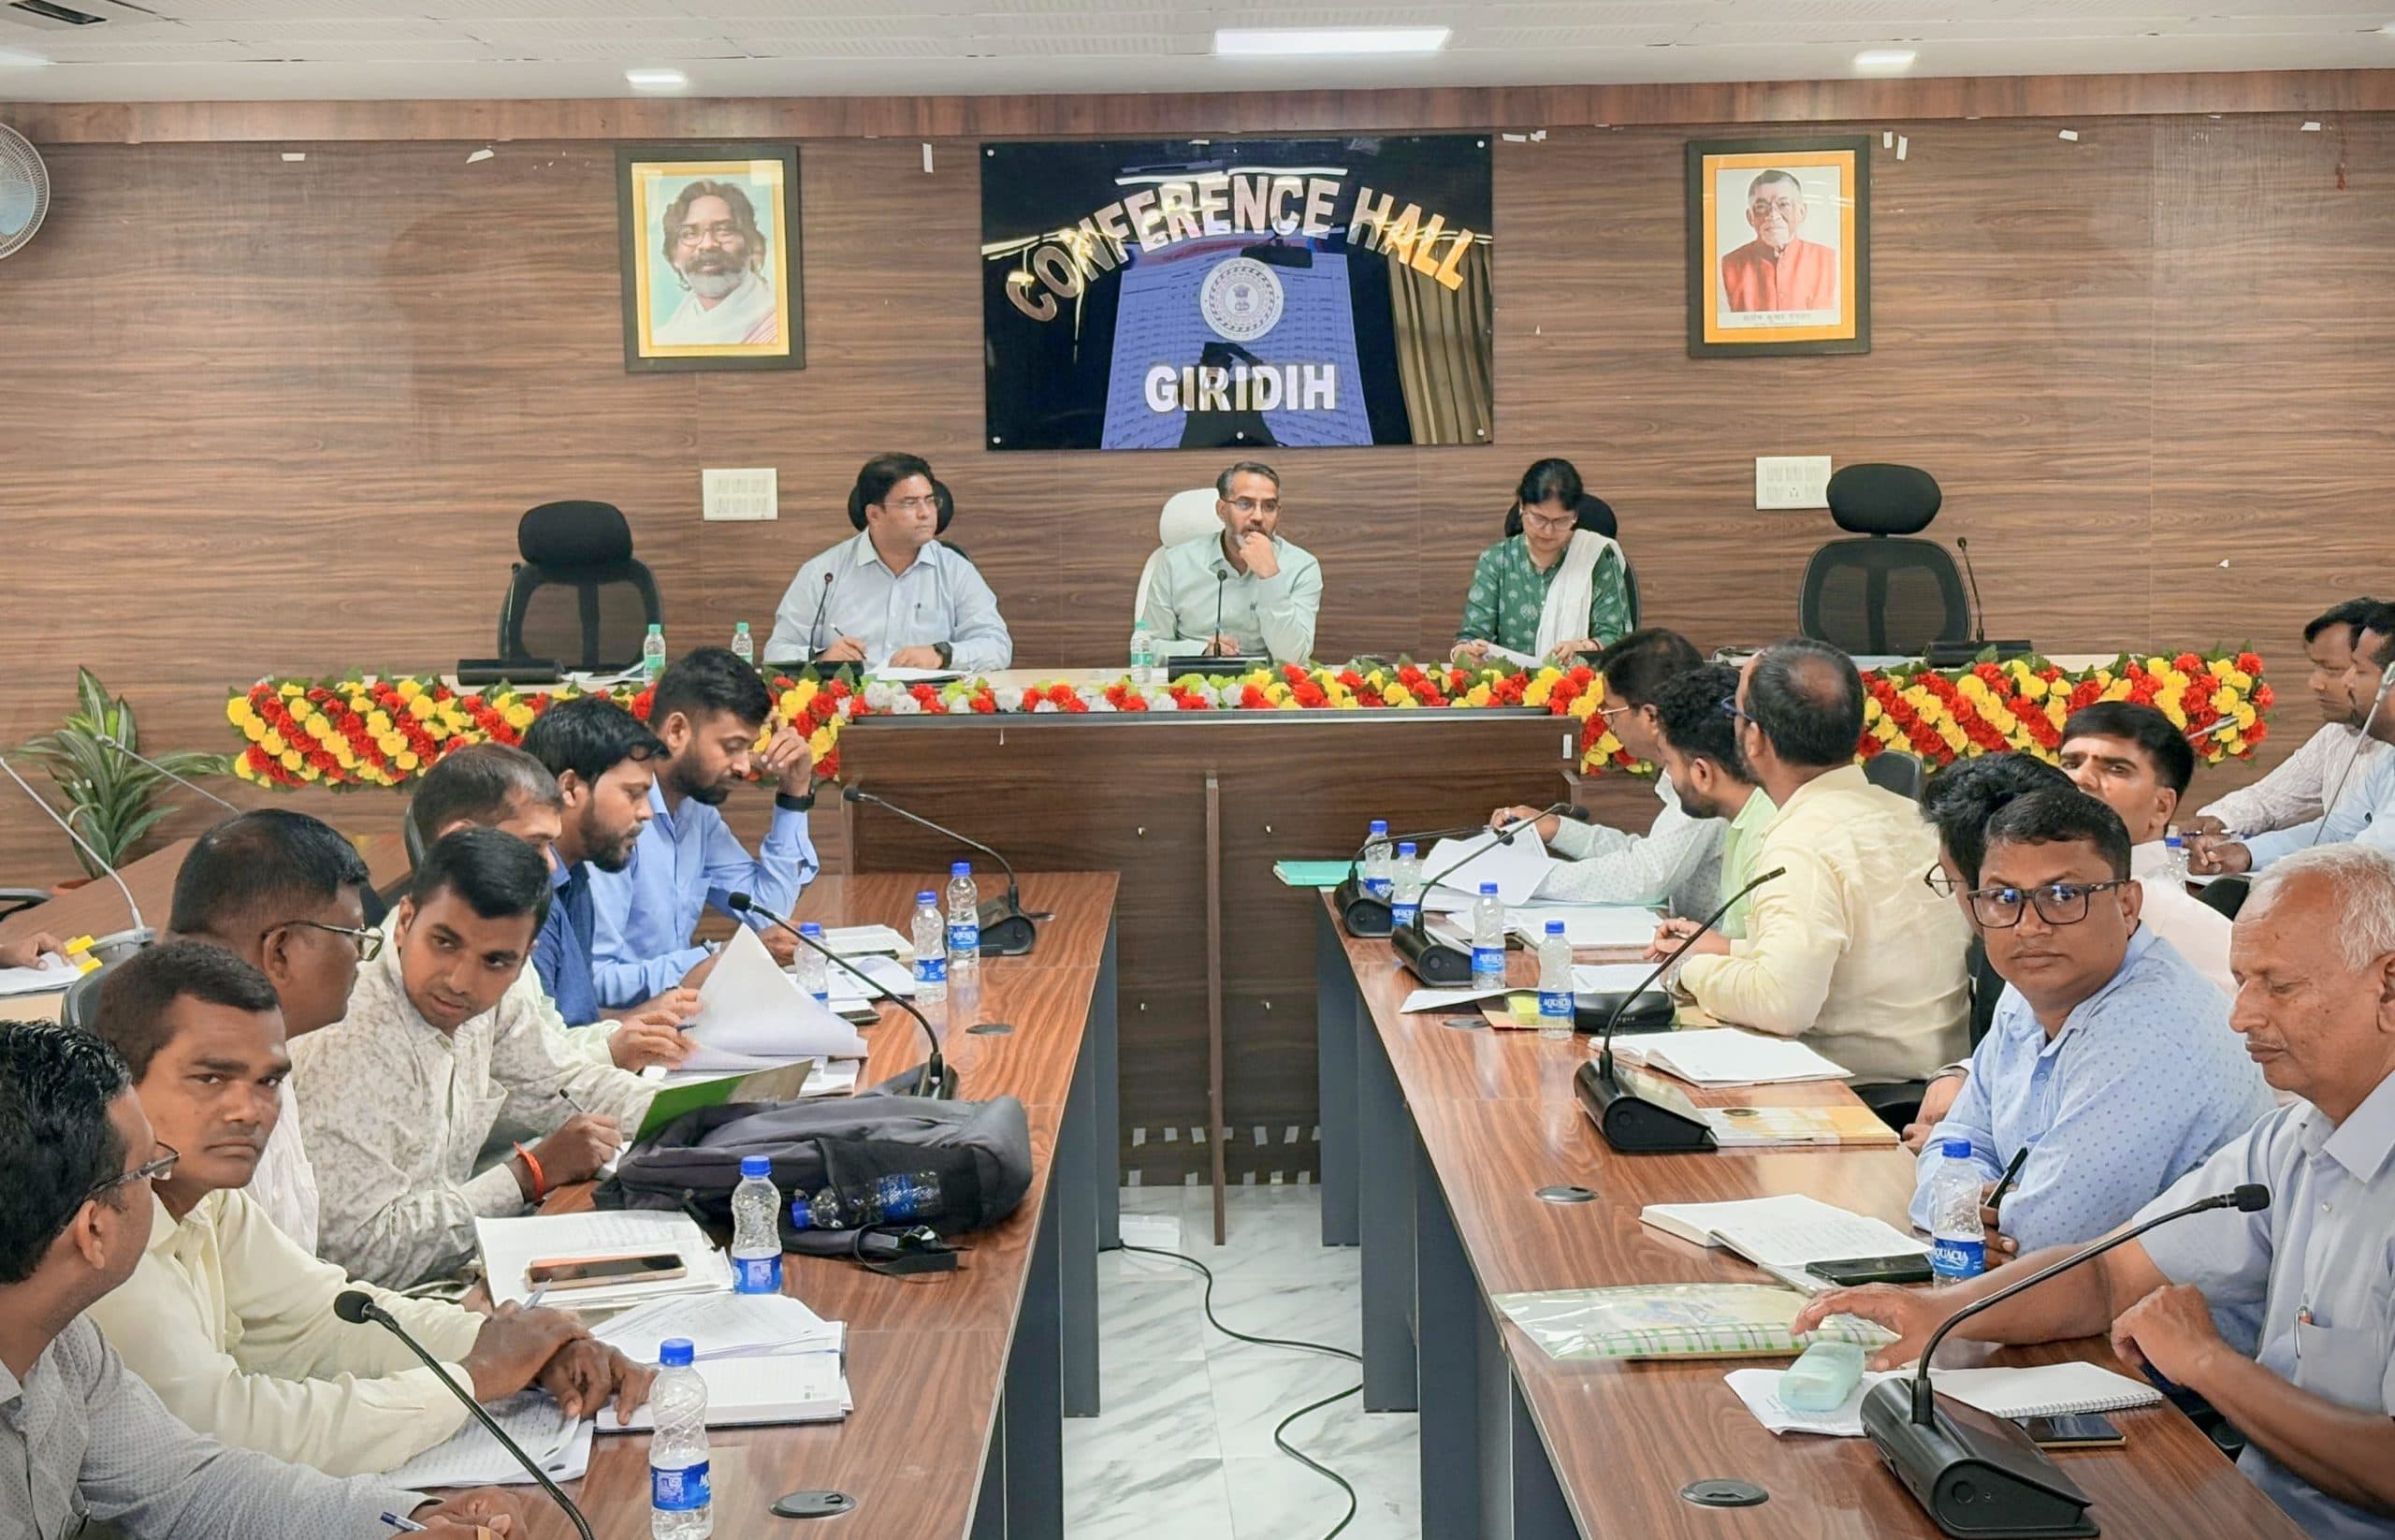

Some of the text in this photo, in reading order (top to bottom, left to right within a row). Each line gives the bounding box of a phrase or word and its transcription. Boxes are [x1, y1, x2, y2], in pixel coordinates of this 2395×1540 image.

[1006, 175, 1474, 322] CONFERENCE HALL
[1144, 364, 1336, 413] GIRIDIH
